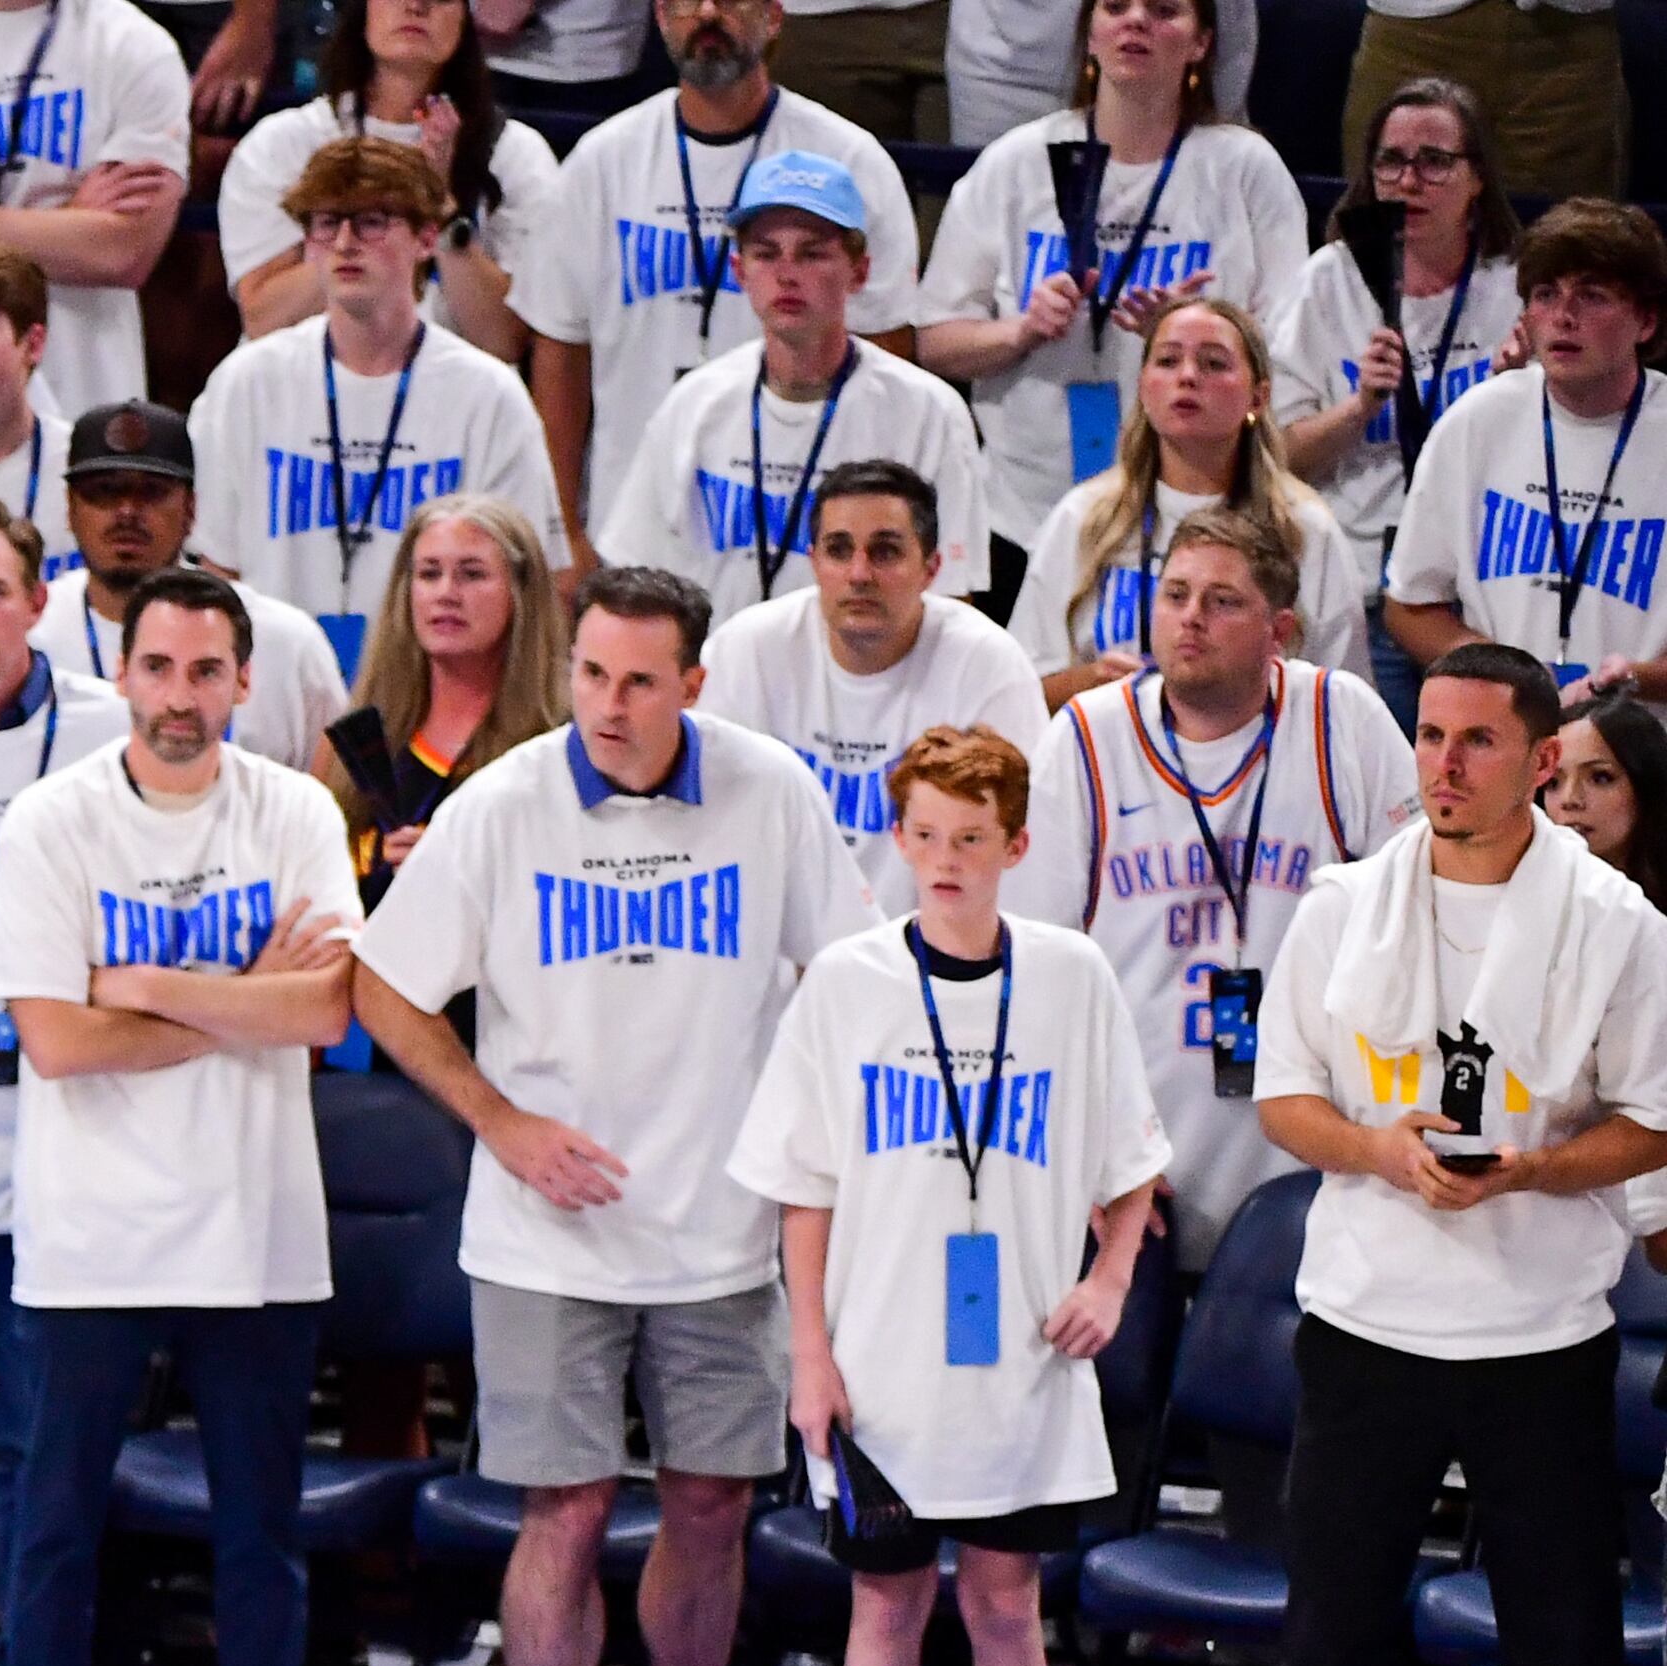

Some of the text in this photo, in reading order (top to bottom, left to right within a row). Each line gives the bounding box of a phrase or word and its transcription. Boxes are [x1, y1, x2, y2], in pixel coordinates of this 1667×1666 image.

[1525, 485, 1624, 508] OKAHOMA
[581, 854, 693, 870] OKLAHOMA
[615, 869, 660, 881] CITY
[534, 863, 741, 968] THUNDER
[904, 1047, 1016, 1063] OKAHOA
